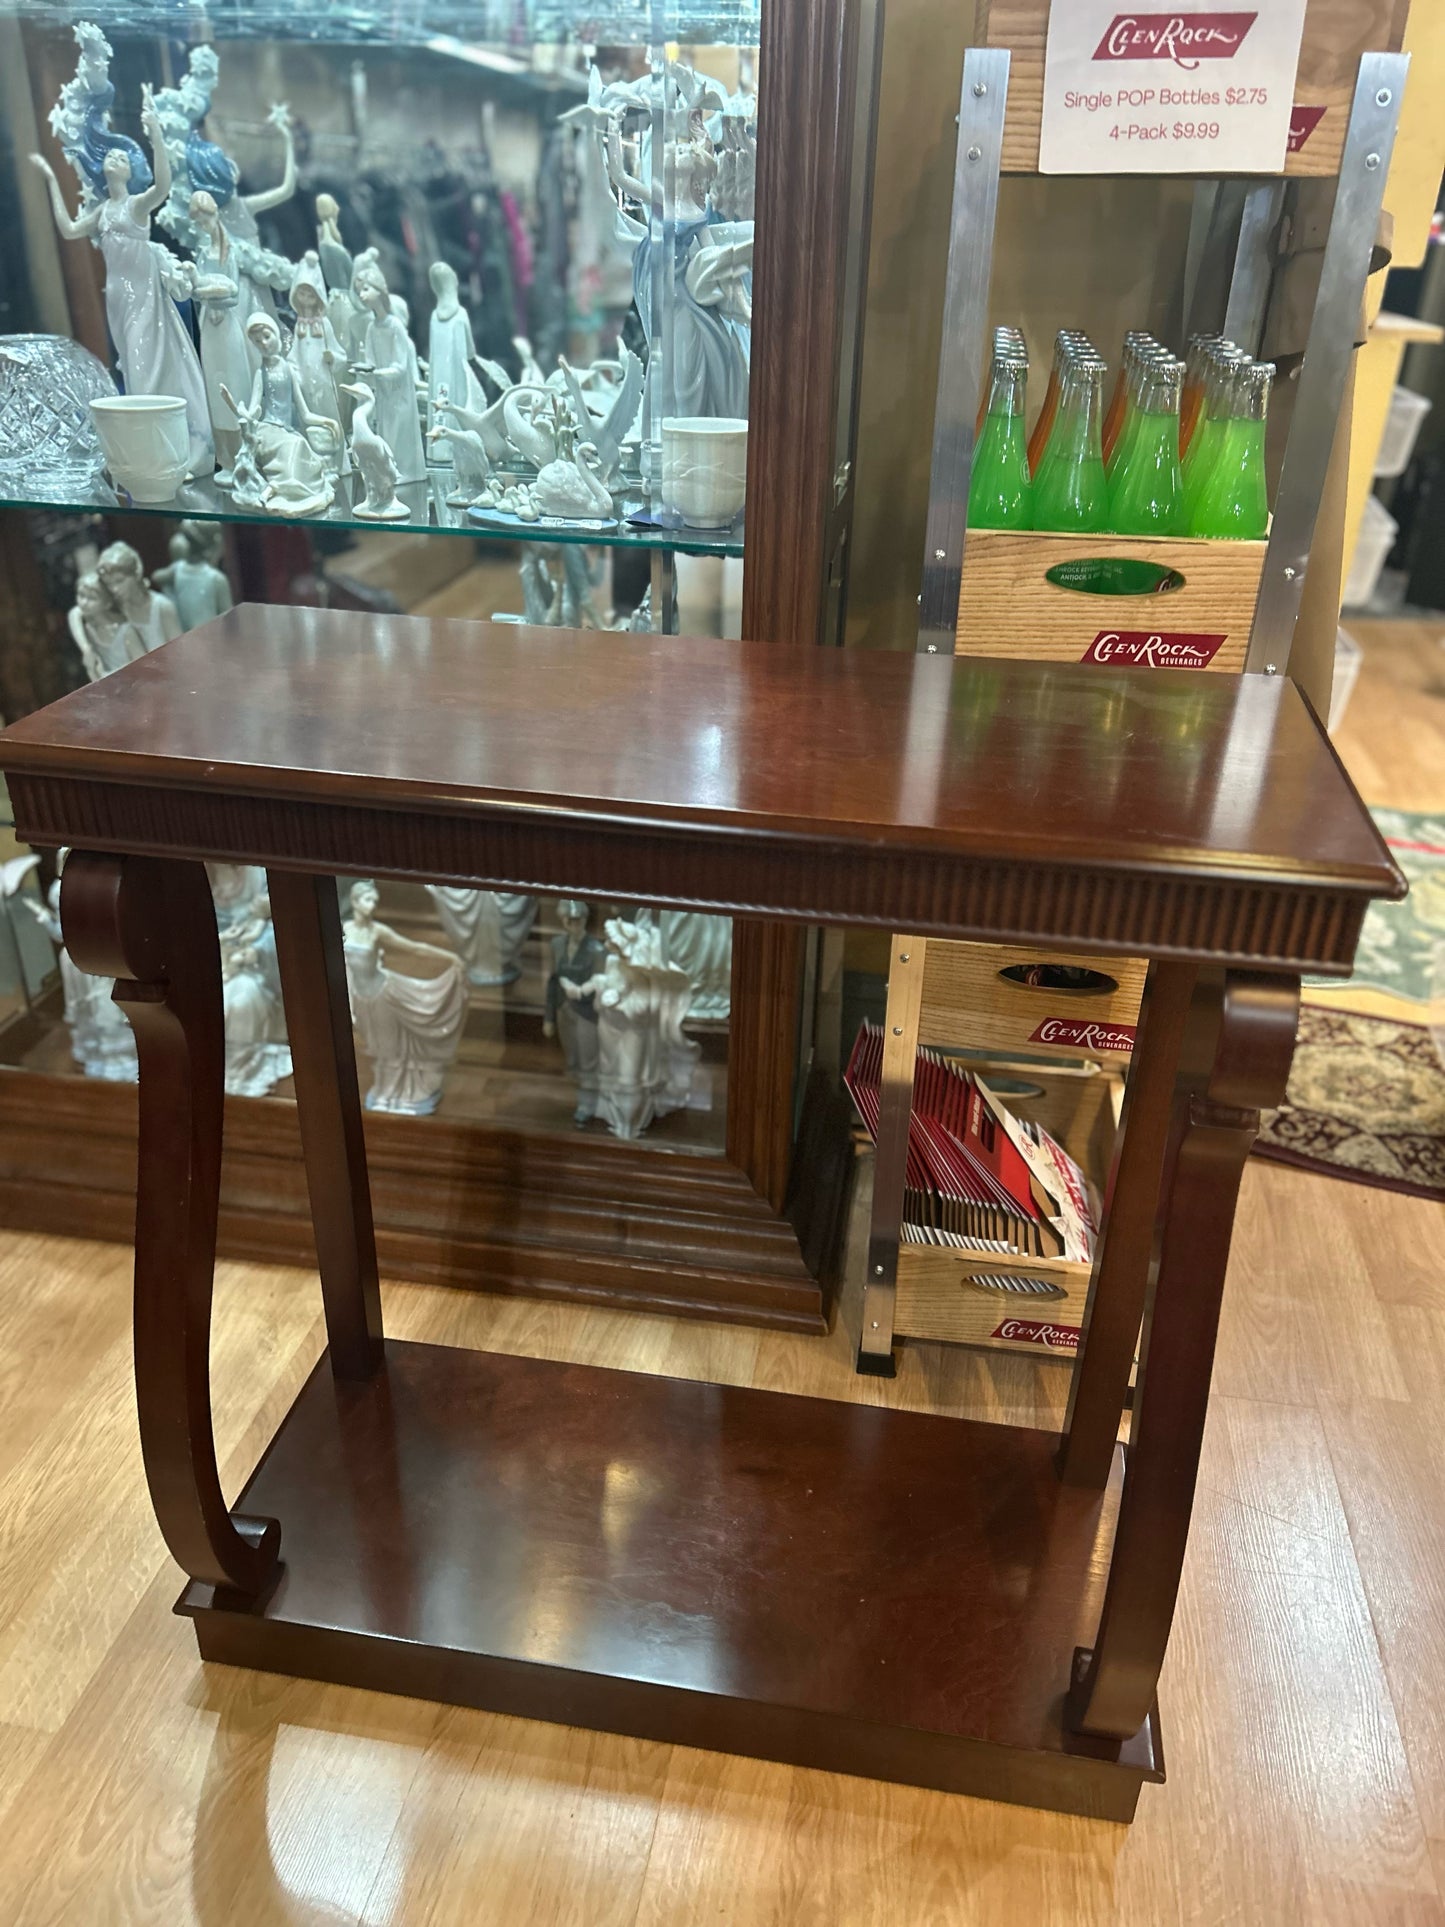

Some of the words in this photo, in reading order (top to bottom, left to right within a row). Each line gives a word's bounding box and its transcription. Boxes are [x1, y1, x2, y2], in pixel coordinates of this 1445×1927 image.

[1064, 91, 1113, 112] Single
[1117, 89, 1155, 106] POP
[1160, 88, 1220, 106] Bottles
[1225, 87, 1268, 105] $2.75
[1109, 123, 1167, 141] 4-Pack
[1172, 122, 1220, 140] $9.99
[1160, 658, 1203, 667] BEVERAGES
